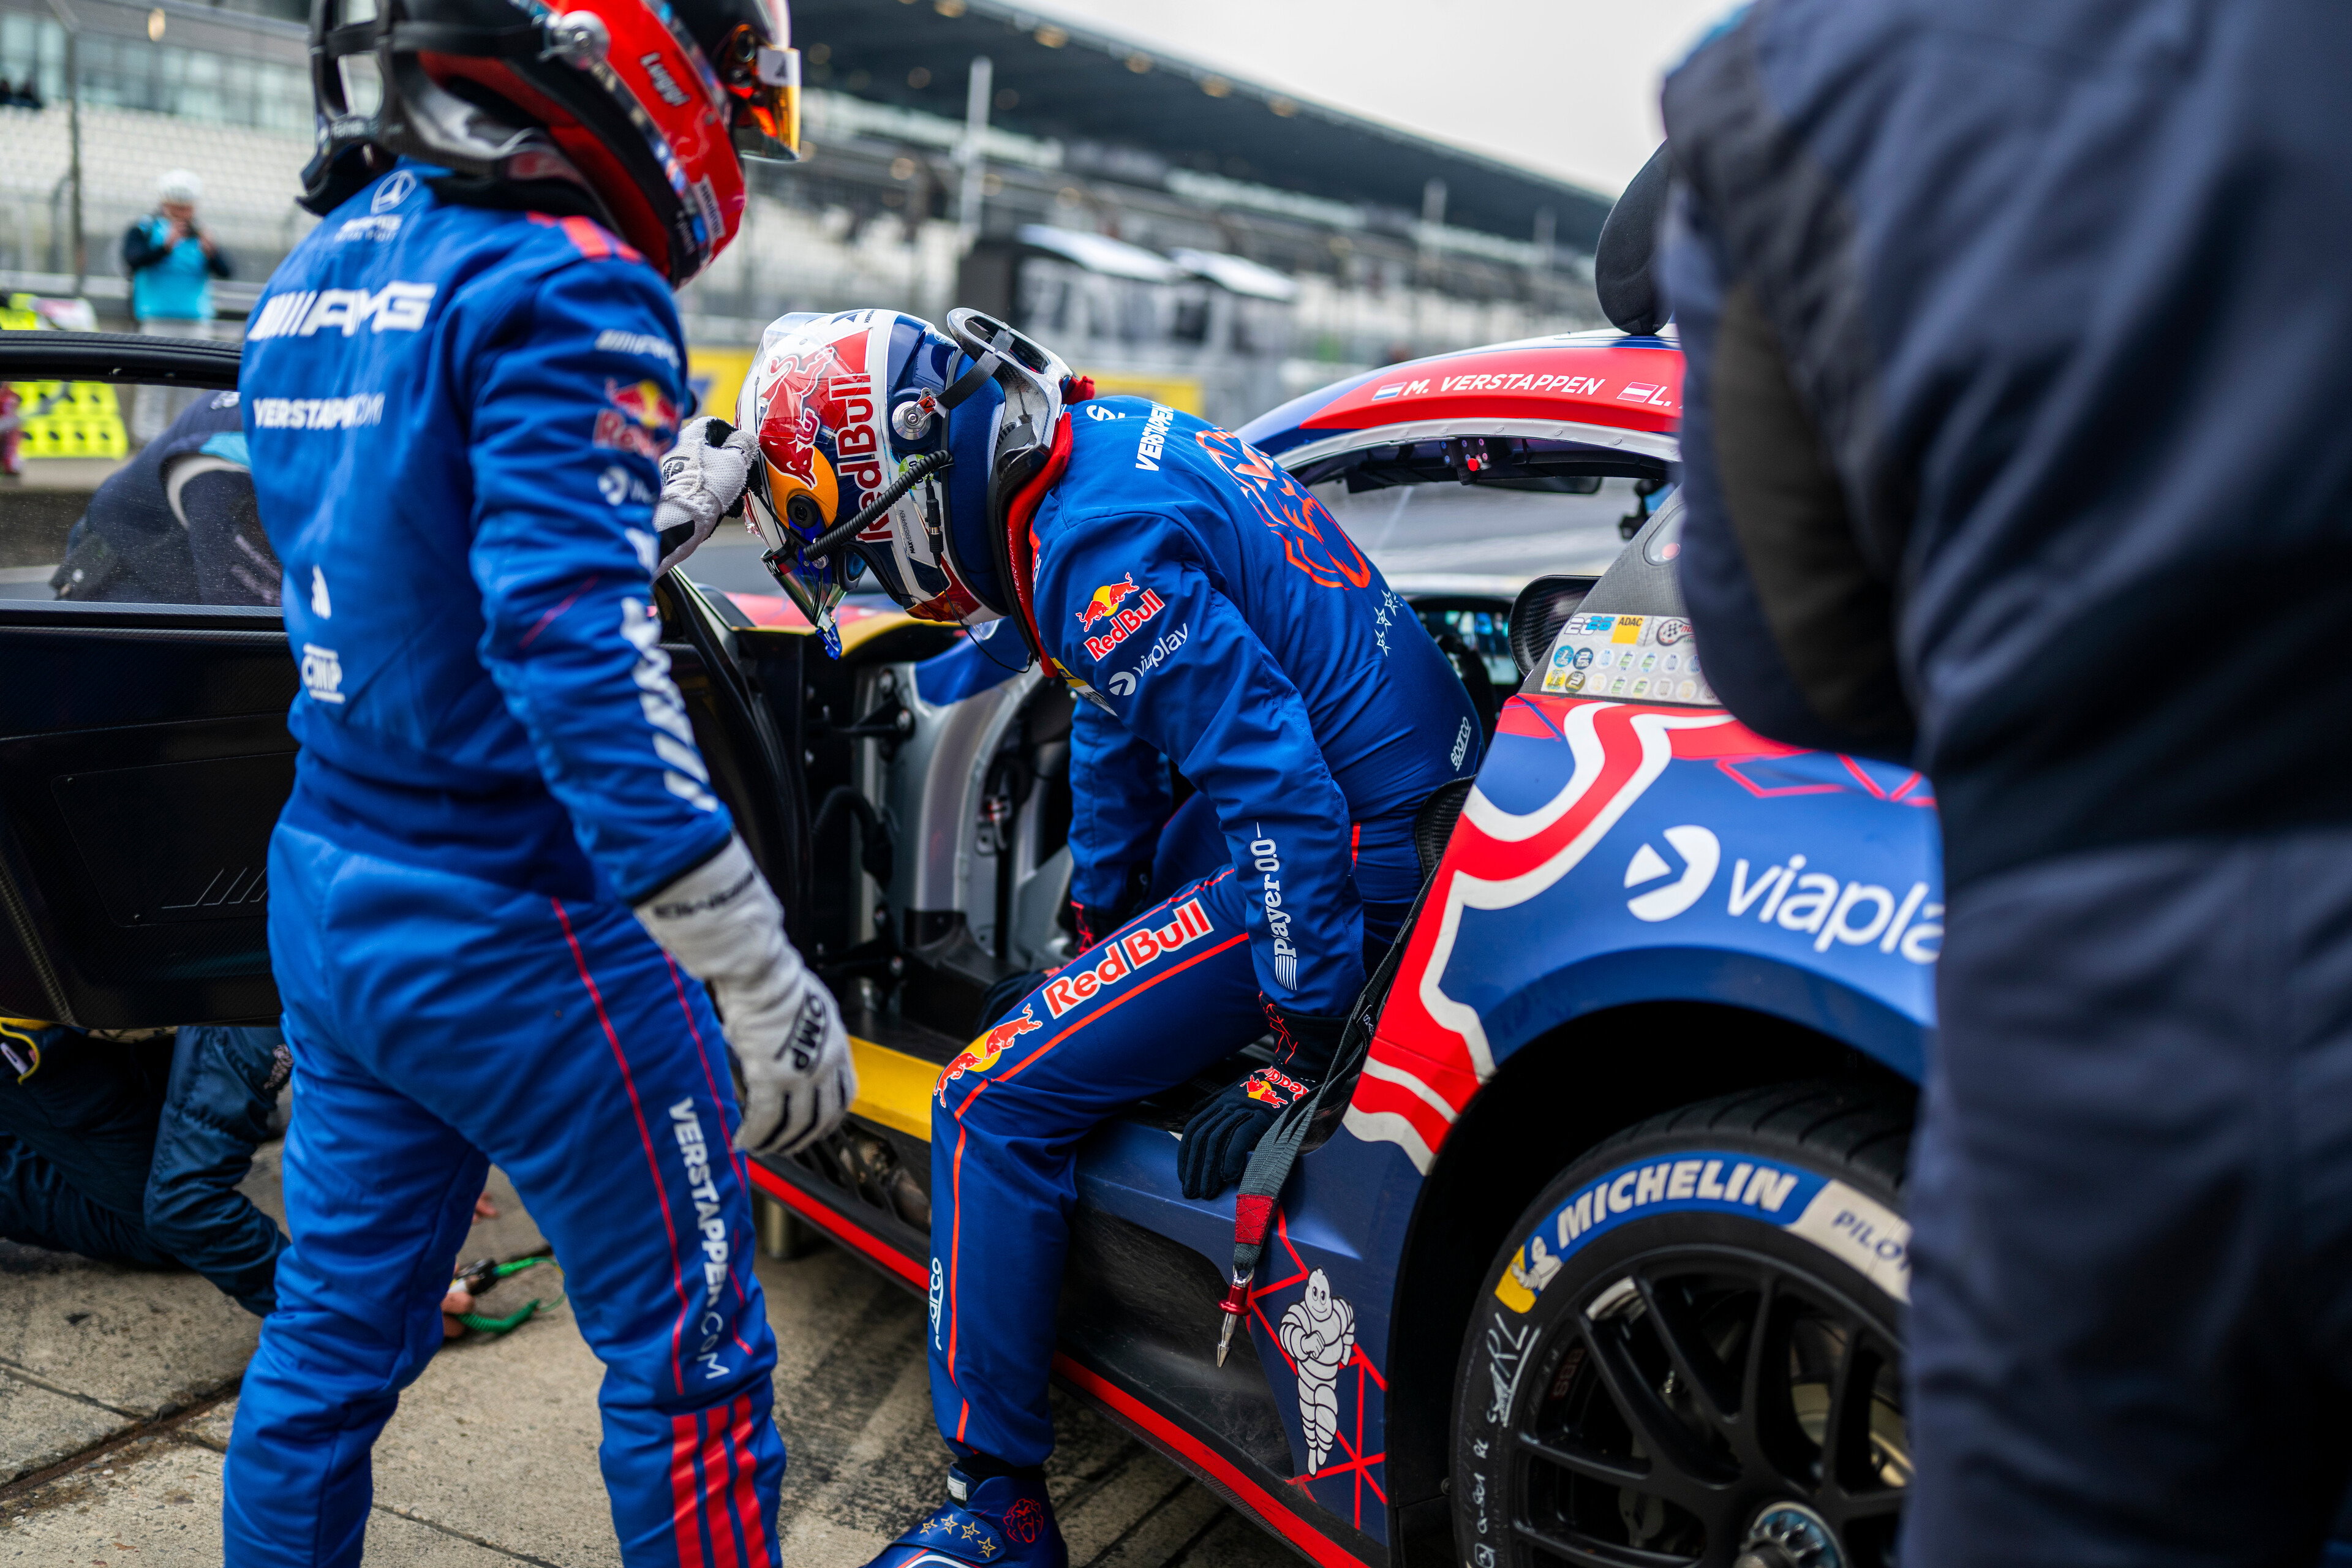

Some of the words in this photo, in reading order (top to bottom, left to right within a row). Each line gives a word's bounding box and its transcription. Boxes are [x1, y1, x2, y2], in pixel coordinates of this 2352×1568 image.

[298, 281, 438, 338] AMG
[831, 374, 878, 456] Bull
[1403, 379, 1429, 396] M.
[1441, 373, 1605, 396] VERSTAPPEN
[1084, 617, 1129, 662] Red
[1117, 588, 1166, 635] Bull
[1133, 622, 1188, 677] viaplay
[1618, 617, 1643, 627] ADAC
[1450, 716, 1471, 771] sparco
[1264, 873, 1298, 957] Player
[1042, 941, 1131, 1020] Red
[1121, 897, 1215, 971] Bull
[1557, 1160, 1800, 1250] MICHELIN
